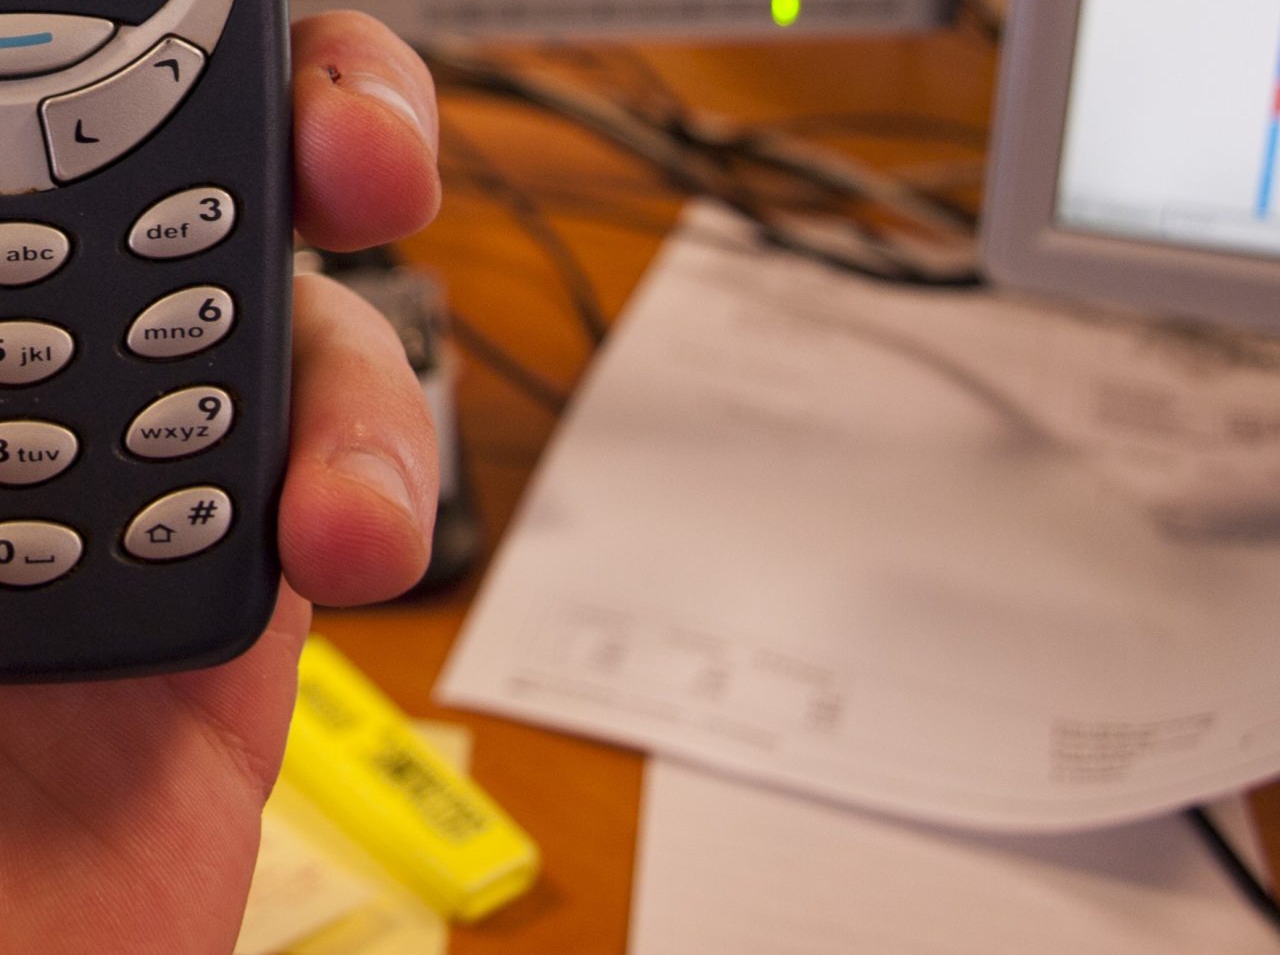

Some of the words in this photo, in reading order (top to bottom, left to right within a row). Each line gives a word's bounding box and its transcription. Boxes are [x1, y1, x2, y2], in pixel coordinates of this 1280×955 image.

[146, 222, 190, 240] def
[199, 197, 222, 222] 3
[6, 245, 54, 262] abc
[144, 326, 205, 341] mno
[197, 298, 222, 323] 6
[19, 346, 52, 367] jkl
[140, 425, 209, 443] wxyz
[197, 396, 222, 421] 9
[17, 448, 60, 464] tuv
[187, 500, 218, 526] #
